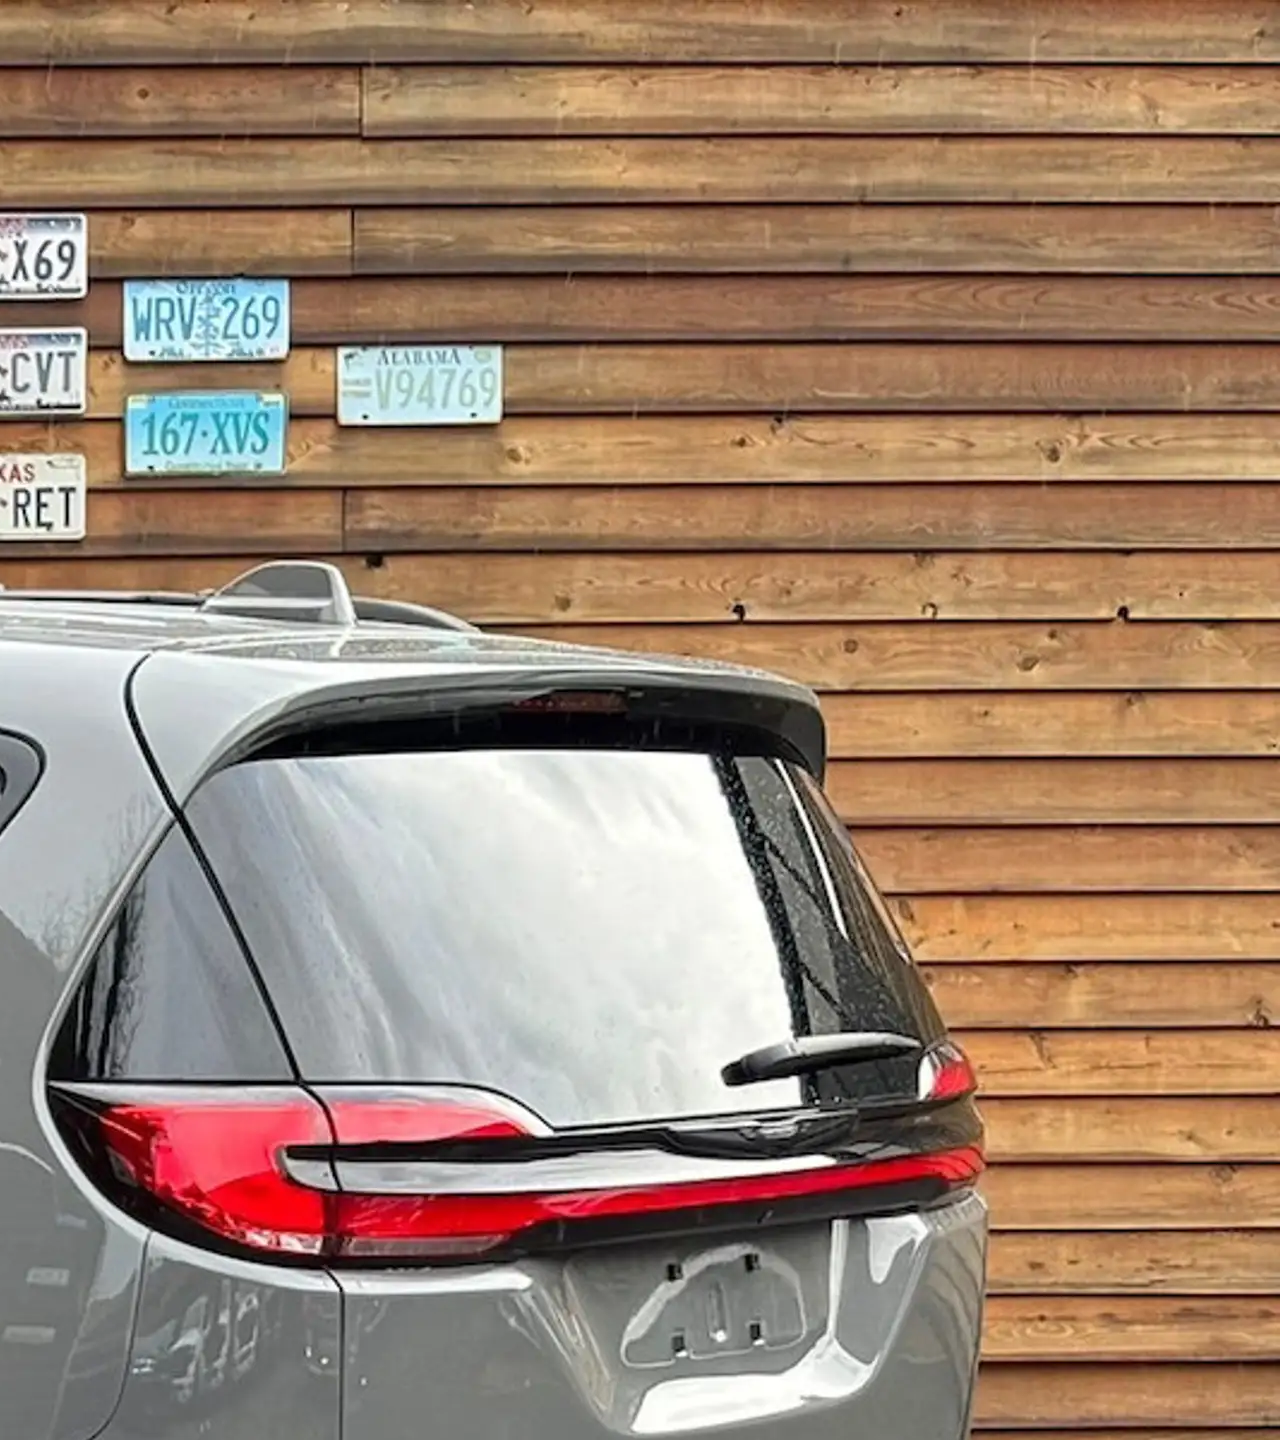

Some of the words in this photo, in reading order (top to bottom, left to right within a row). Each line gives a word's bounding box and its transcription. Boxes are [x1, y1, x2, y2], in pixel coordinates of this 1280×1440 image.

[132, 296, 197, 342] WRV
[221, 295, 281, 340] 269
[377, 348, 462, 366] ALABAMA
[375, 367, 497, 411] V94769
